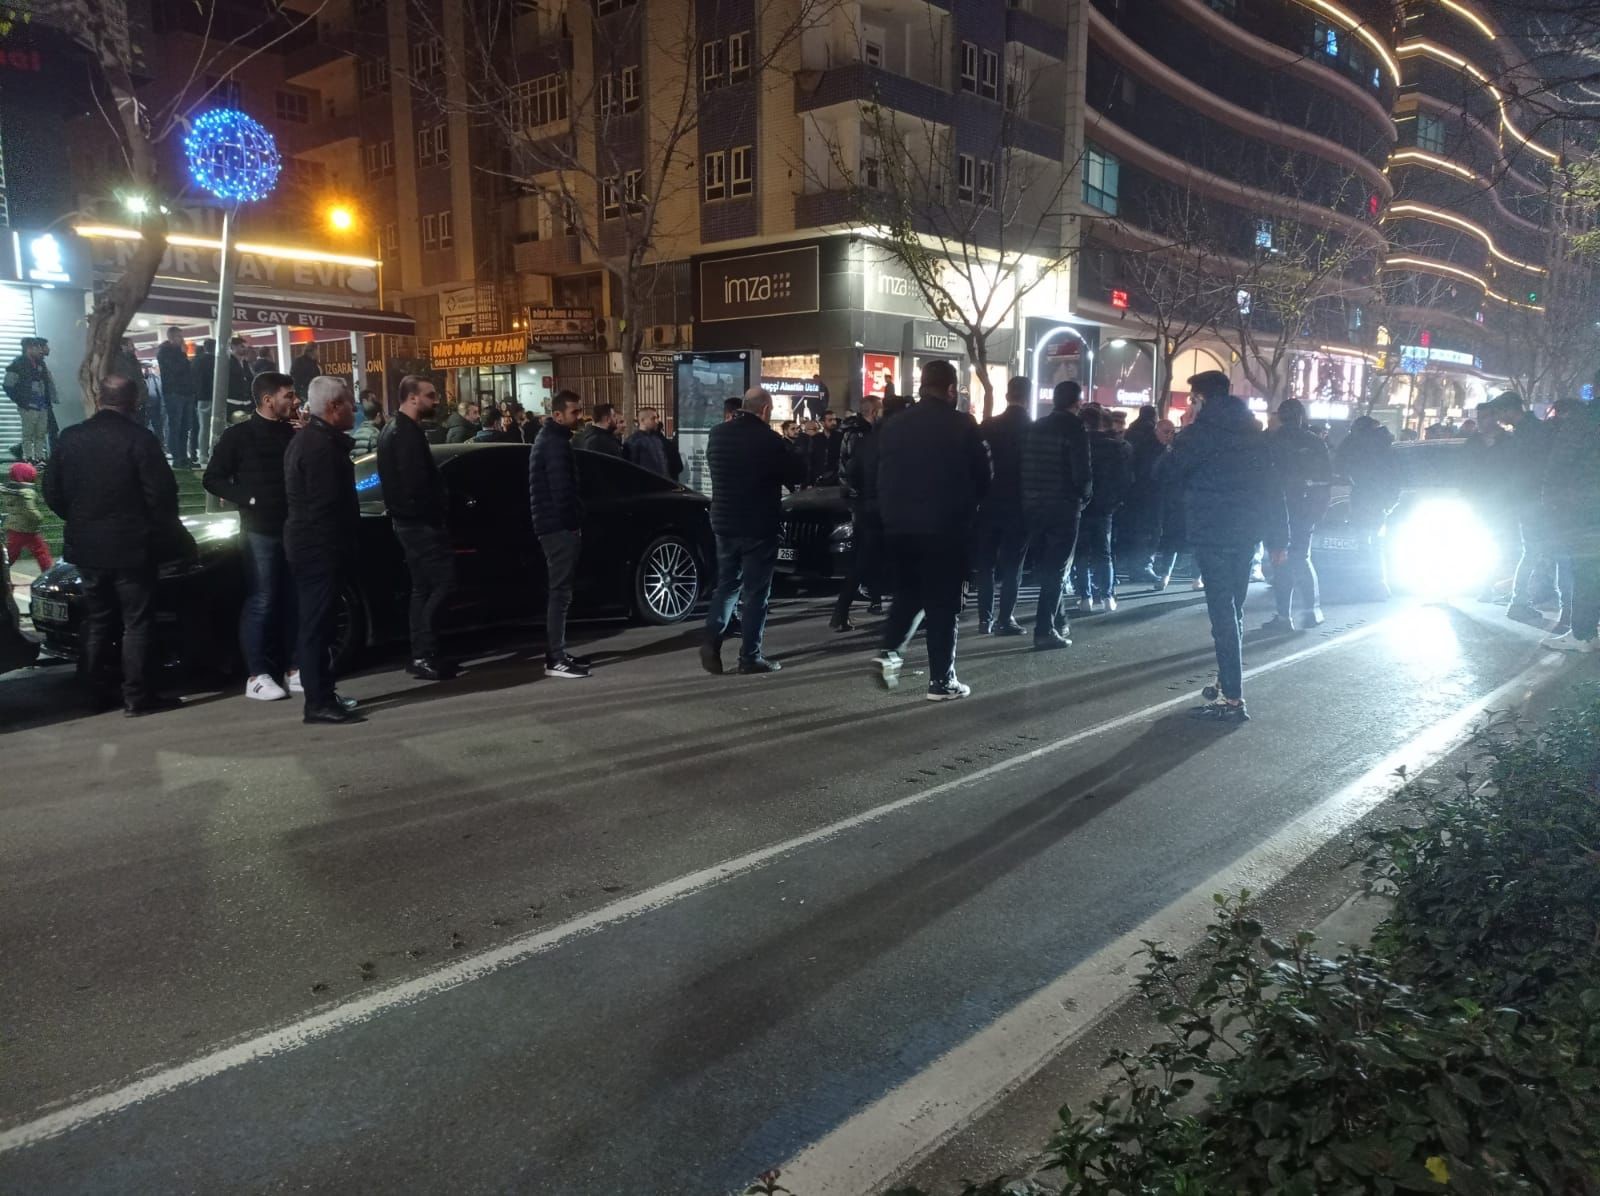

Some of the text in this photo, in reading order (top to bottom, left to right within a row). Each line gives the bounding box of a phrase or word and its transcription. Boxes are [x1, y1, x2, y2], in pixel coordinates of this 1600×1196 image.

[724, 274, 771, 304] imza
[878, 271, 908, 297] imza
[211, 305, 248, 321] NR
[257, 310, 289, 324] ÇAY
[925, 331, 948, 349] imza
